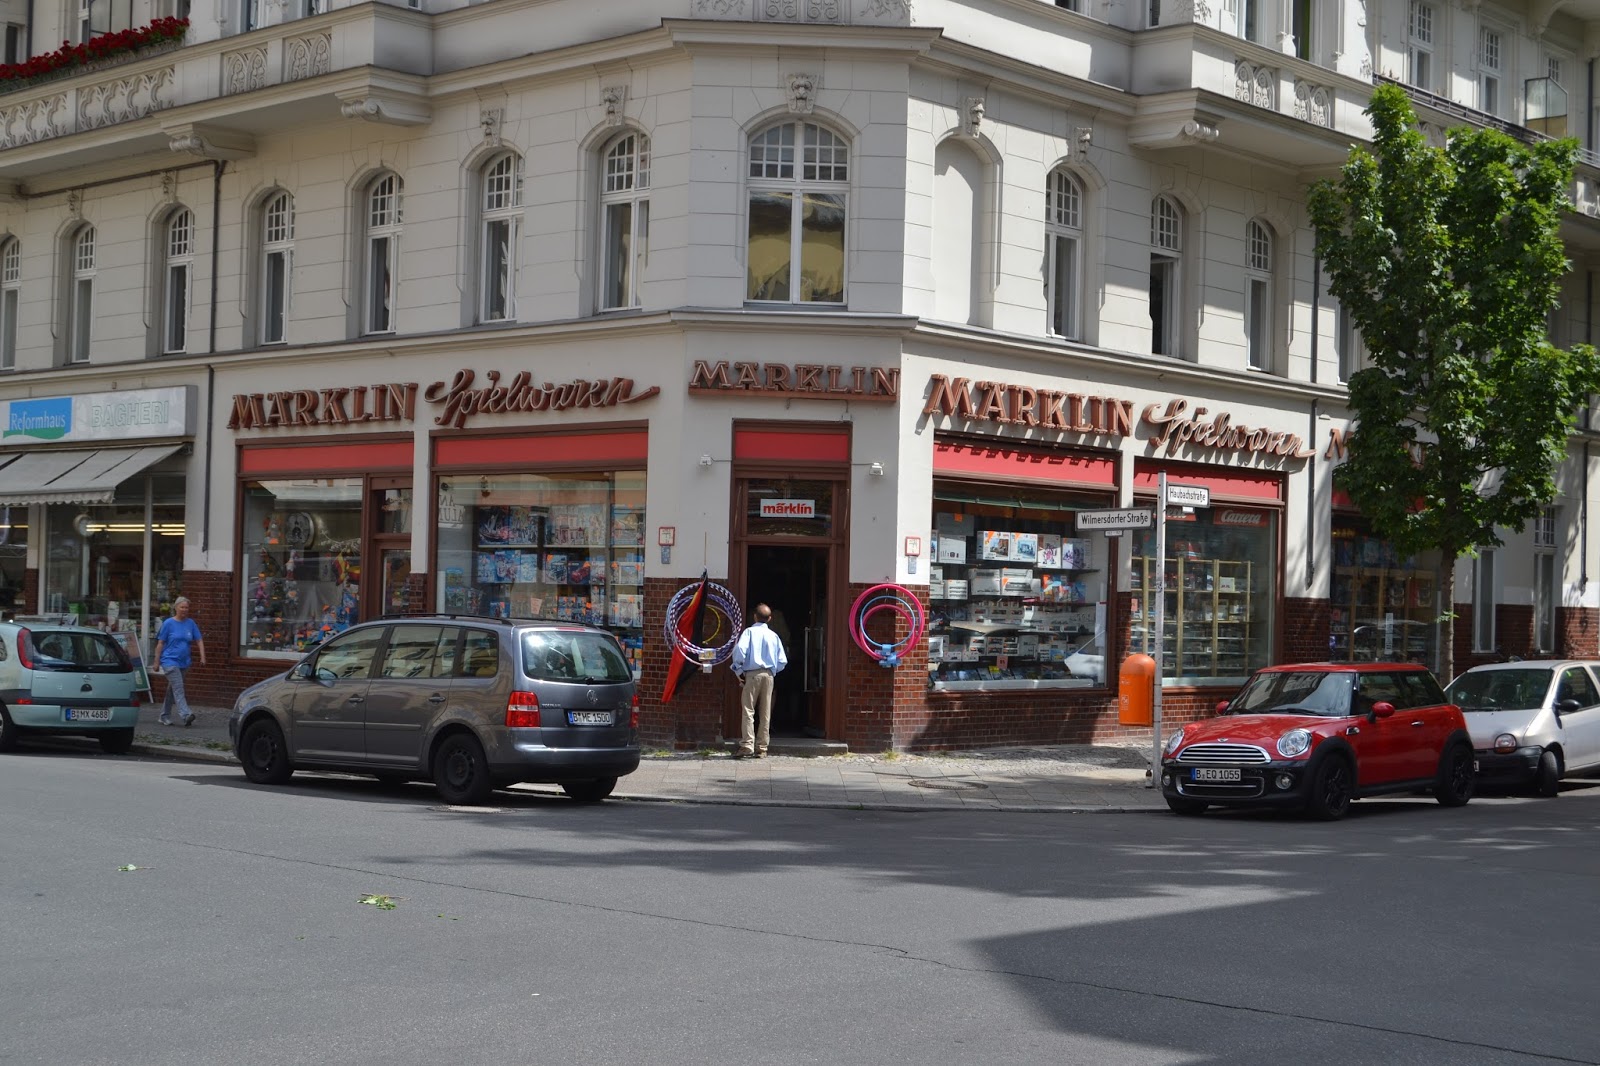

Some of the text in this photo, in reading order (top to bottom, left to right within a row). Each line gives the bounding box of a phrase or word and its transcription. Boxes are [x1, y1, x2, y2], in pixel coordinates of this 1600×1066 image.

[688, 360, 900, 395] MÄRKLIN
[226, 382, 418, 429] MÄRKLIN
[425, 368, 660, 428] Spielwaren
[923, 373, 1134, 437] MÄRKLIN
[11, 410, 66, 434] Reformhaus
[91, 400, 169, 428] BAGHERI
[1140, 398, 1317, 459] Spielwaren
[1169, 487, 1206, 503] Haubachstraße
[762, 502, 812, 515] märklin
[1081, 513, 1127, 525] Wilmersdorfer
[1127, 511, 1149, 525] Straße
[1220, 509, 1262, 524] Carrera
[71, 709, 109, 719] B MX 4688
[573, 712, 611, 723] B ME 1500
[1196, 769, 1240, 780] B EQ 1055
